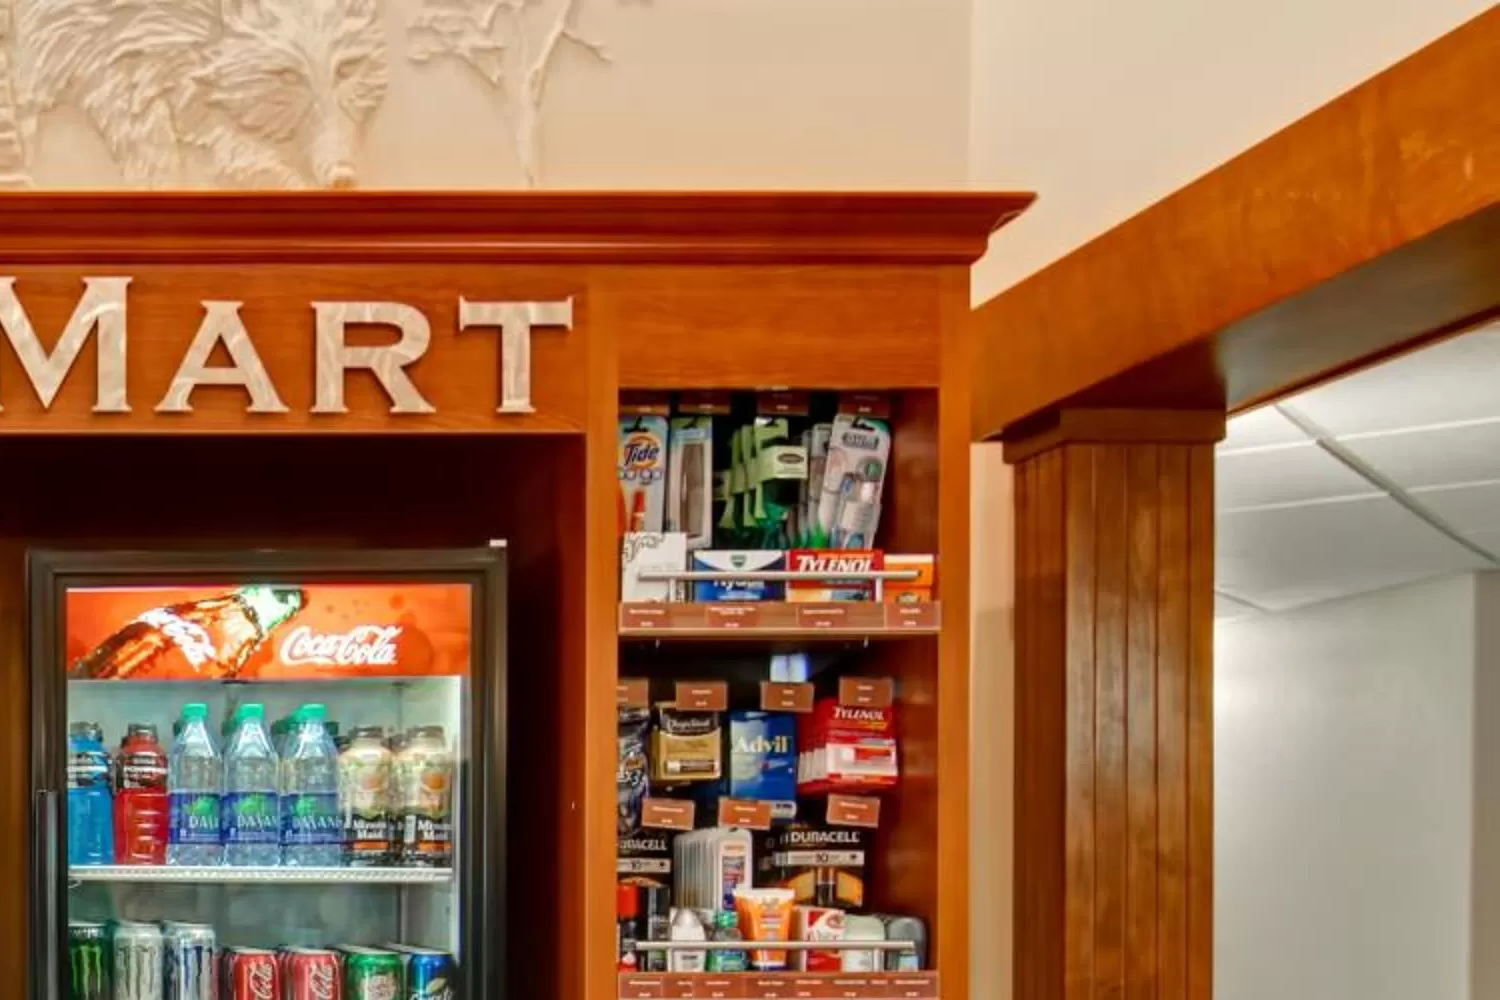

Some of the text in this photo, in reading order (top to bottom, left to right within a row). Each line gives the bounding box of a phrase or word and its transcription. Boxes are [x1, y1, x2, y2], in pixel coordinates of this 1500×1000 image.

[624, 443, 660, 467] Tide
[796, 554, 873, 573] TYLENOL
[279, 624, 405, 666] Coca-Cola
[733, 735, 788, 754] Advil
[789, 831, 861, 843] DURACELL
